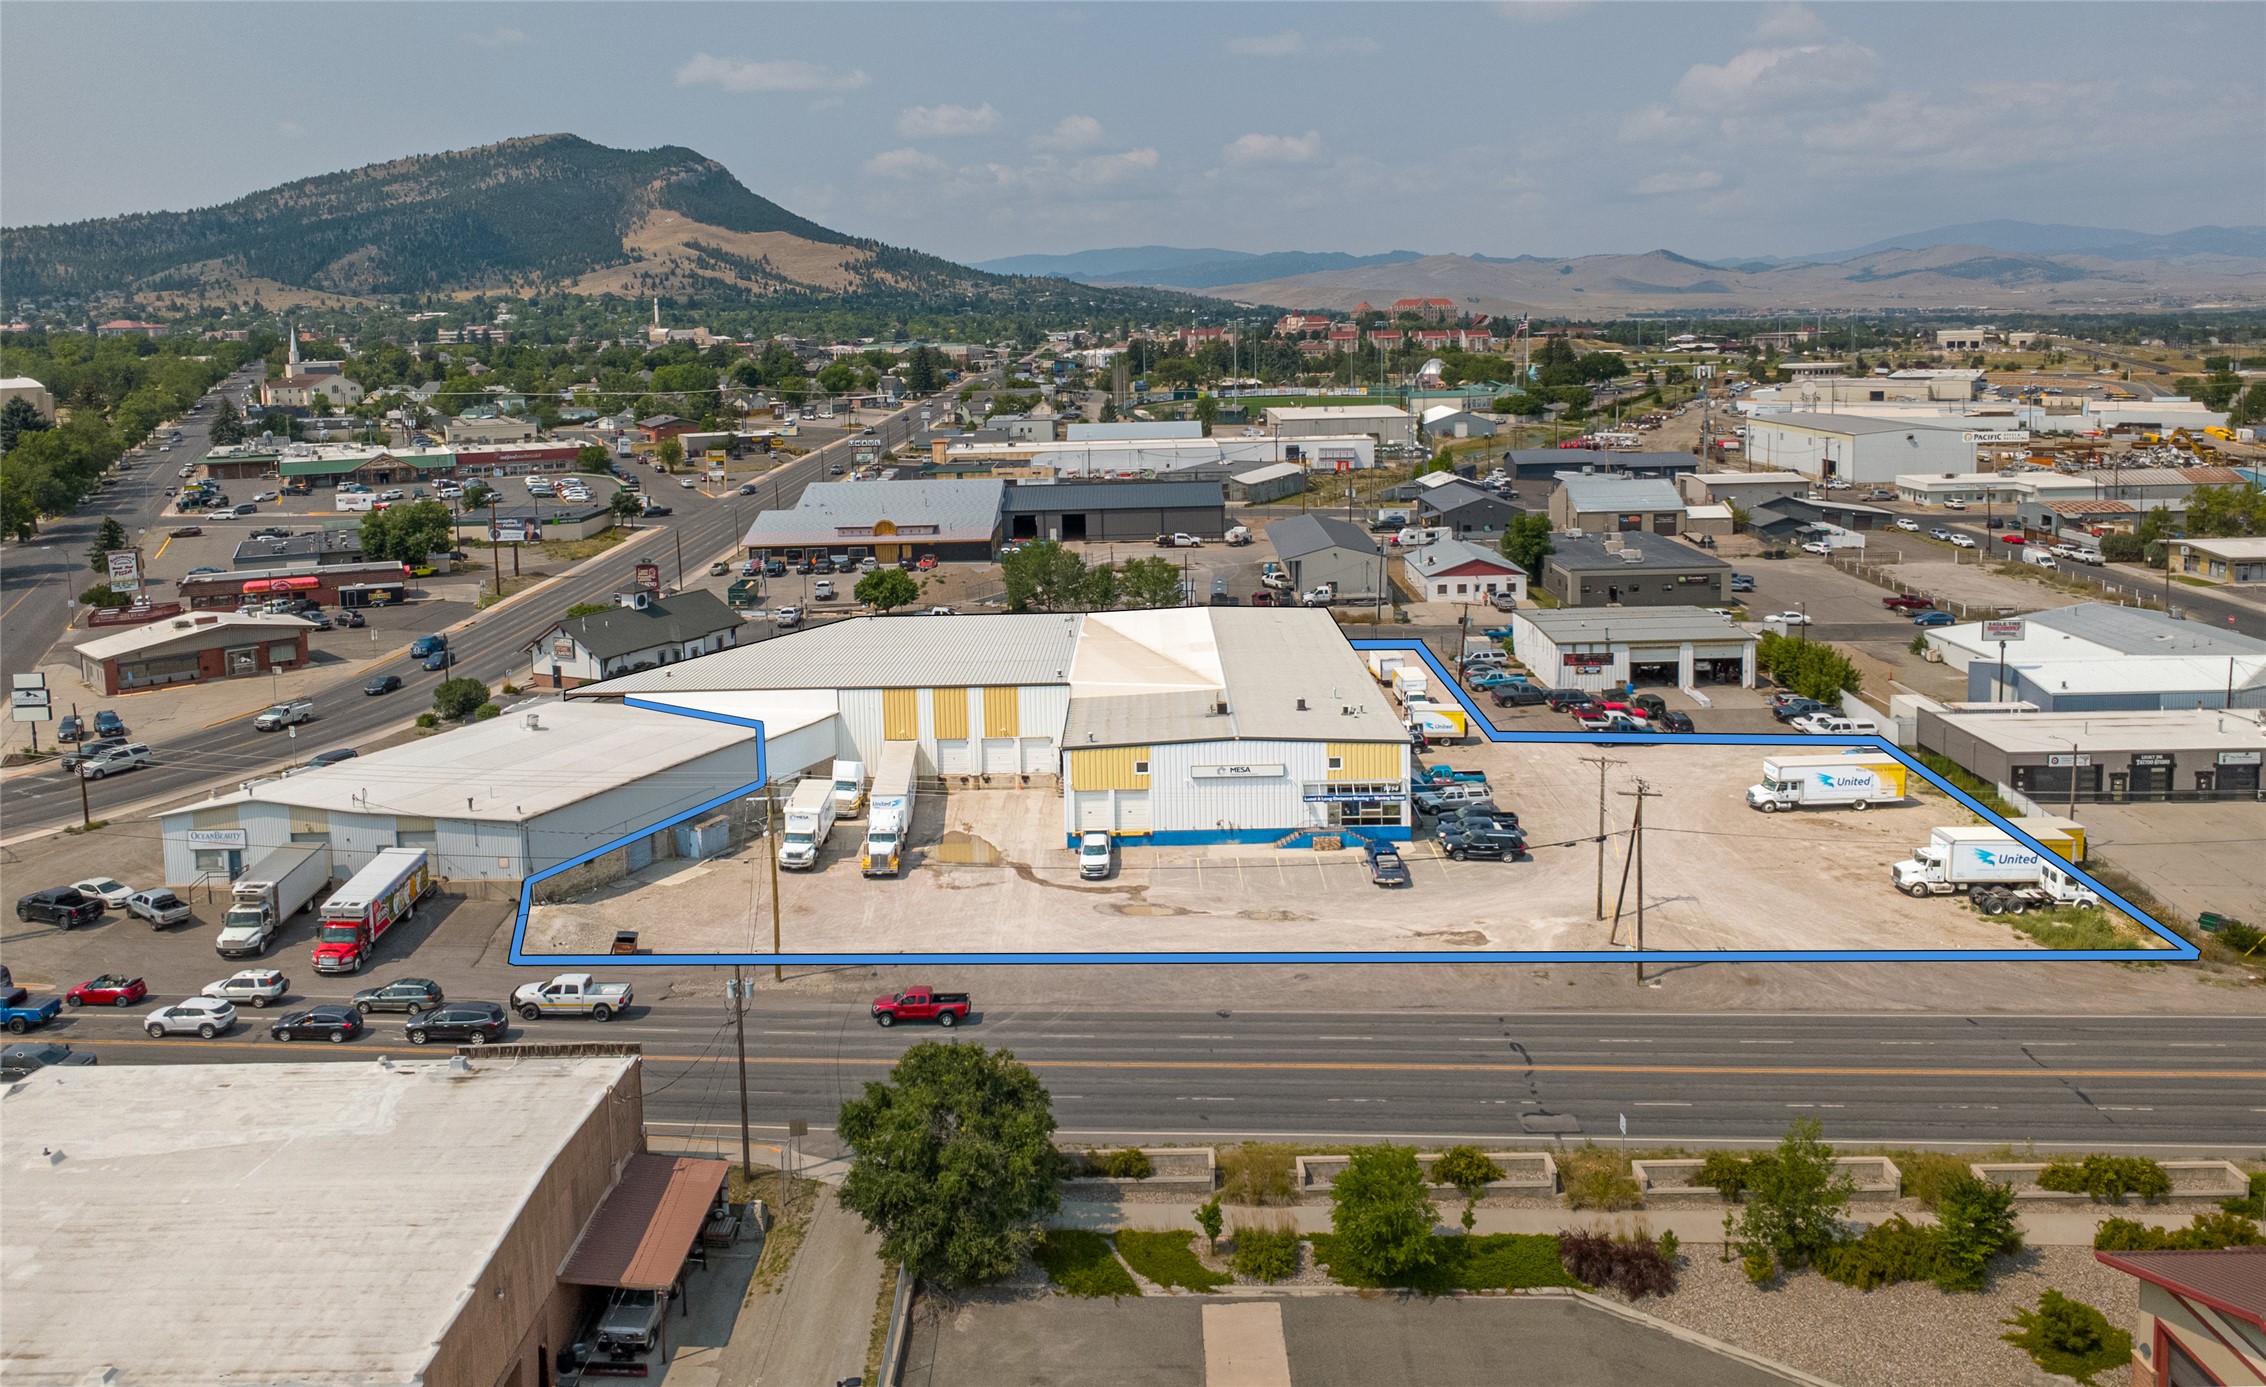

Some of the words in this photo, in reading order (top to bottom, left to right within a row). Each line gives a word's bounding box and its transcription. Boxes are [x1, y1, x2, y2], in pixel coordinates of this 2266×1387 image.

[1973, 433, 2002, 441] PACIFIC
[1837, 776, 1871, 787] United
[1998, 854, 2038, 865] United
